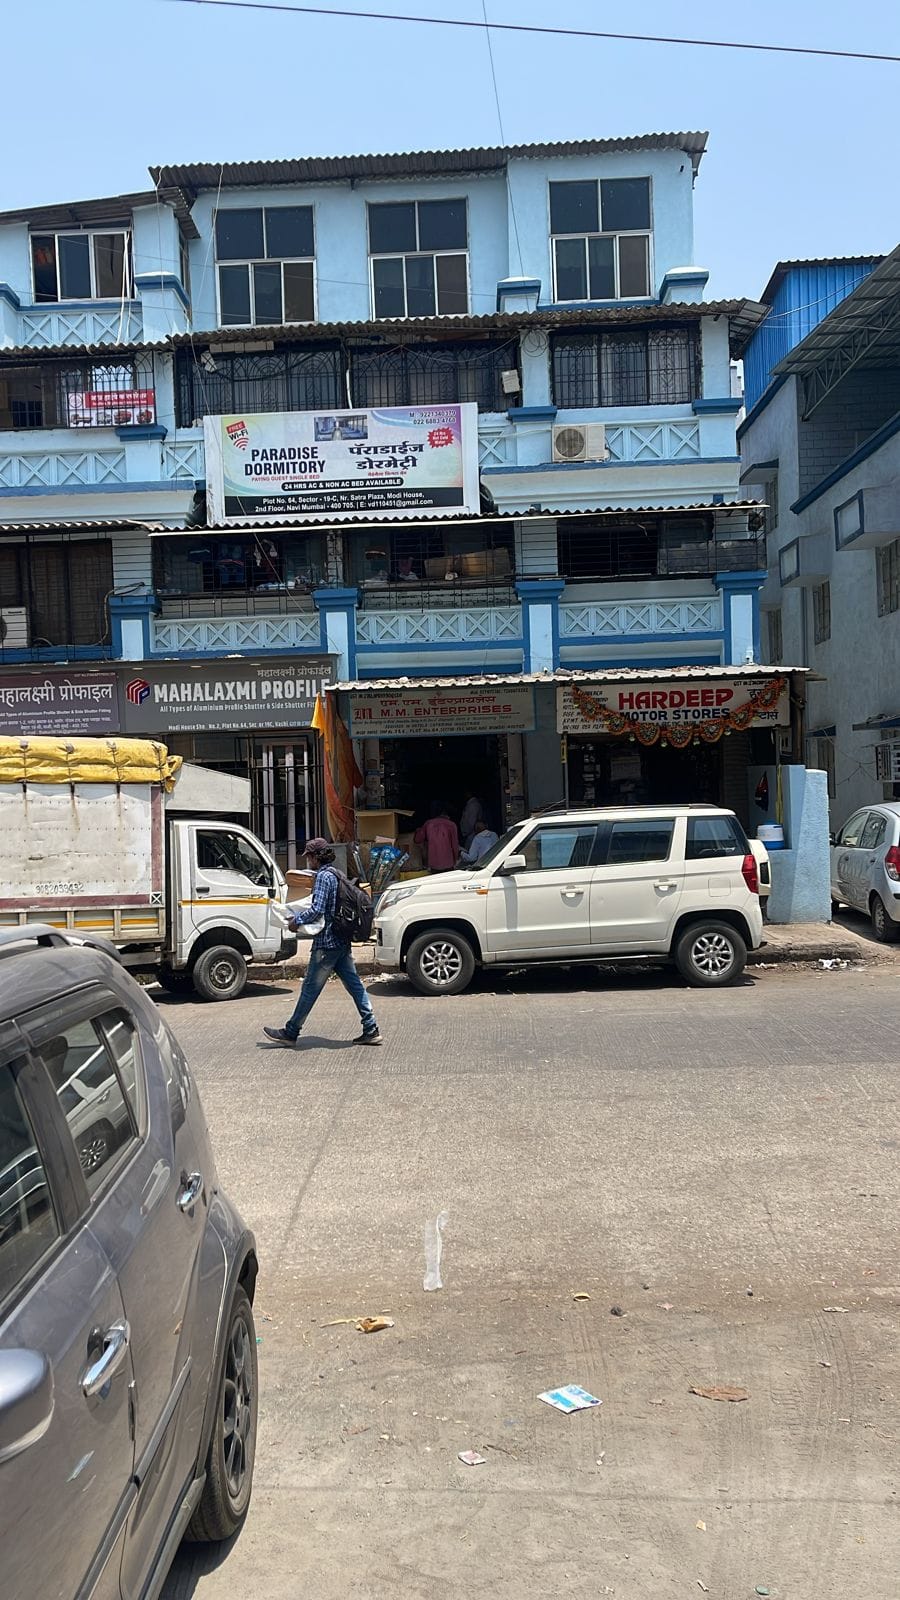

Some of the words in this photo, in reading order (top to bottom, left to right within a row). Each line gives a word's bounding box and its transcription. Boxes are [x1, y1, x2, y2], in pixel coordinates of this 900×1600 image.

[251, 446, 319, 462] PARADISE
[244, 460, 326, 476] DORMITORY
[355, 455, 418, 471] डोरमेट्री
[365, 478, 401, 486] AVAILABLE
[262, 497, 276, 505] Plot
[367, 493, 386, 501] Plaza,
[403, 491, 425, 499] House,
[268, 505, 286, 513] Floor,
[301, 503, 326, 511] Mumbai
[257, 665, 295, 678] महालक्ष्मी
[58, 679, 114, 703] प्रोफाइल
[153, 680, 257, 703] MAHALAXMI
[618, 688, 734, 710] HARDEEP
[160, 705, 168, 713] All
[168, 704, 185, 714] Types
[186, 703, 193, 712] of
[193, 703, 225, 712] Aluminium
[224, 702, 244, 711] Profile
[244, 701, 266, 710] Shutter
[271, 701, 284, 709] Side
[284, 700, 306, 709] Shutter
[414, 704, 512, 717] ENTERPRISES
[620, 710, 668, 721] MOTOR
[672, 708, 730, 721] STORES
